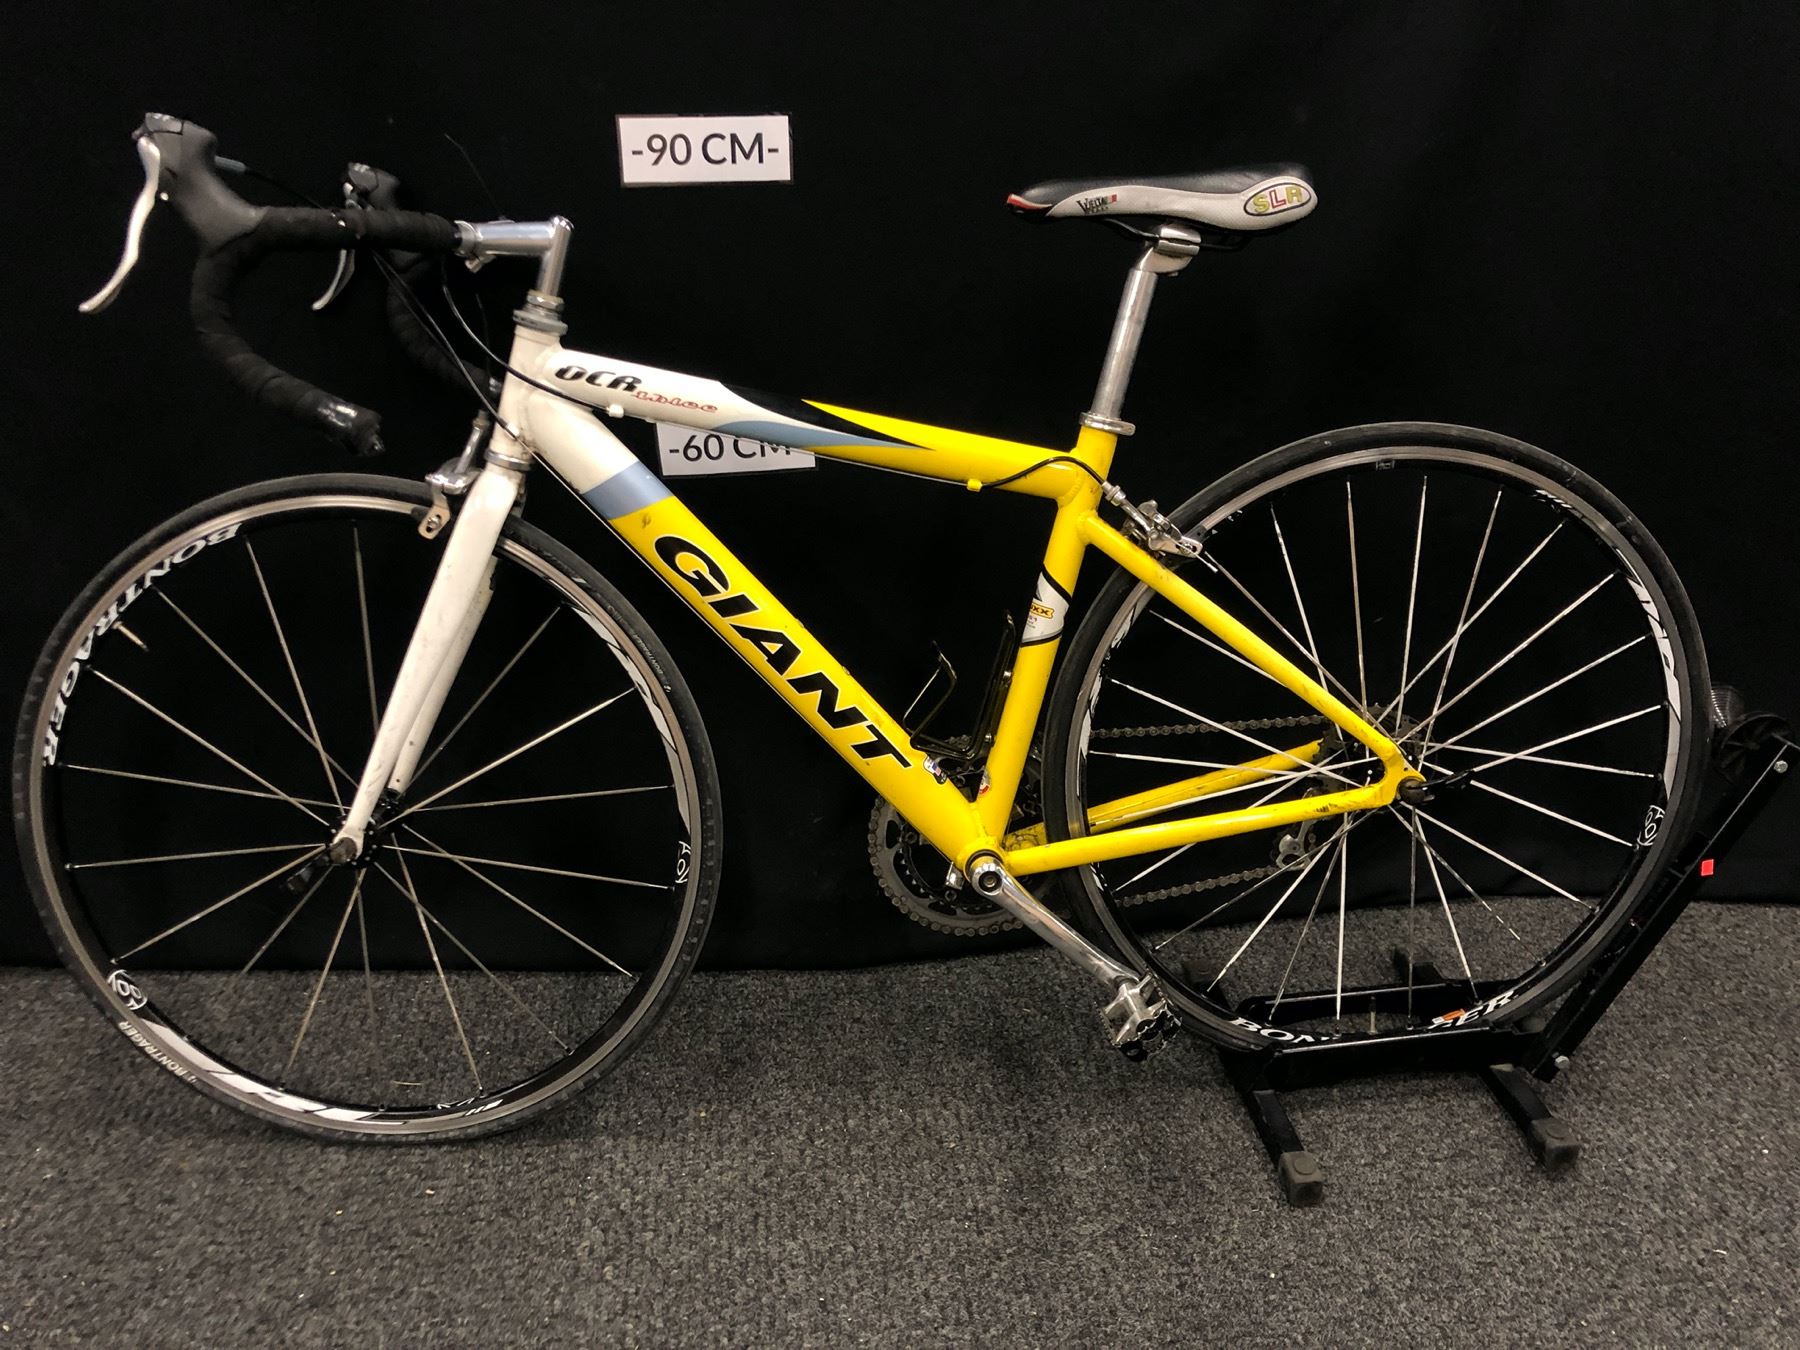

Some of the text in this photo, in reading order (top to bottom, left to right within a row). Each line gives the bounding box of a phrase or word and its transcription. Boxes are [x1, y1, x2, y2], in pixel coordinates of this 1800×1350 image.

[632, 132, 779, 166] -90 CM-
[1253, 186, 1303, 213] SLR
[555, 365, 642, 392] OCR
[43, 523, 243, 767] BONTRAGER
[653, 535, 913, 769] GIANT
